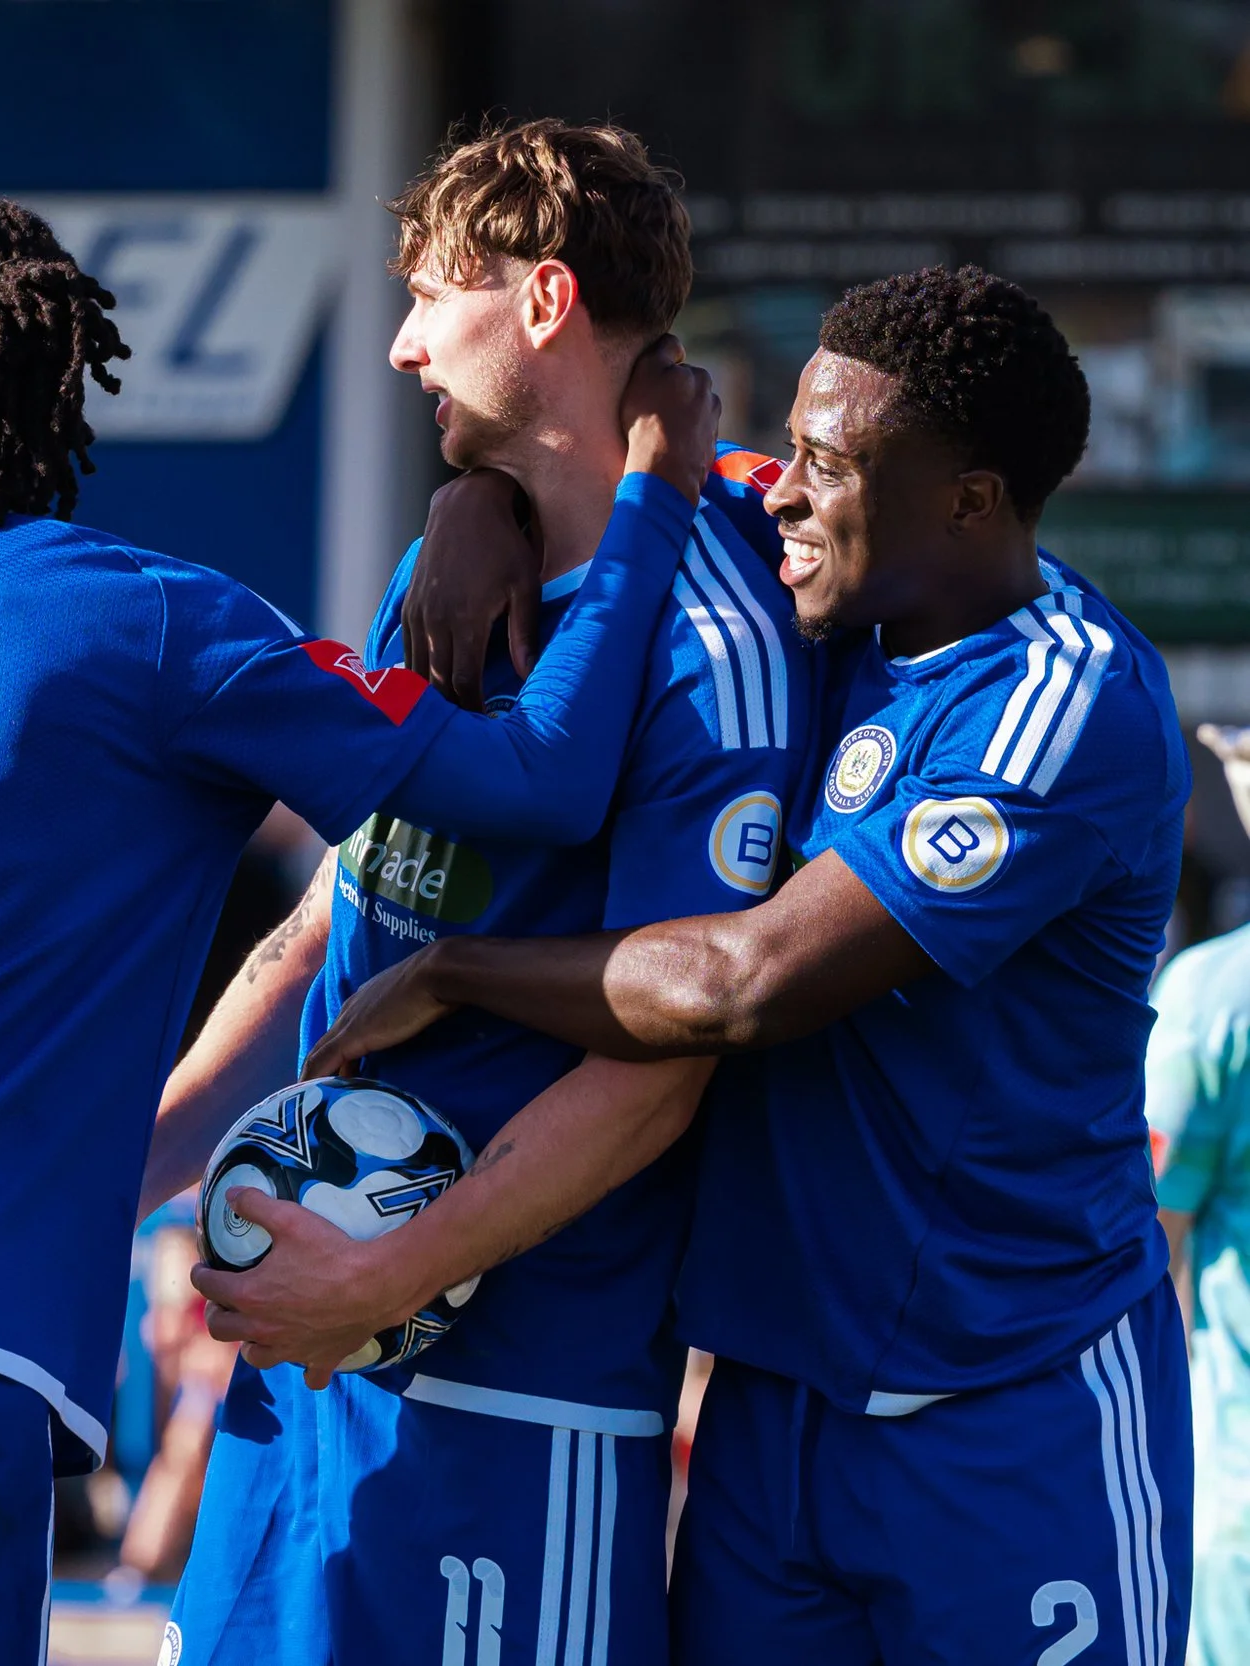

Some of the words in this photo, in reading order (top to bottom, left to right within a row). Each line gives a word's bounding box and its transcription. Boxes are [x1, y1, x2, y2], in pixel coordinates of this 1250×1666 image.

[840, 730, 877, 752] CURZON
[876, 733, 891, 767] ASHTON
[829, 772, 851, 806] FOOTBALL
[855, 785, 875, 804] CLUB
[737, 822, 773, 867] B
[927, 814, 980, 865] B
[347, 829, 446, 899] innacle
[372, 901, 437, 945] Supplies
[1031, 1580, 1099, 1666] 2
